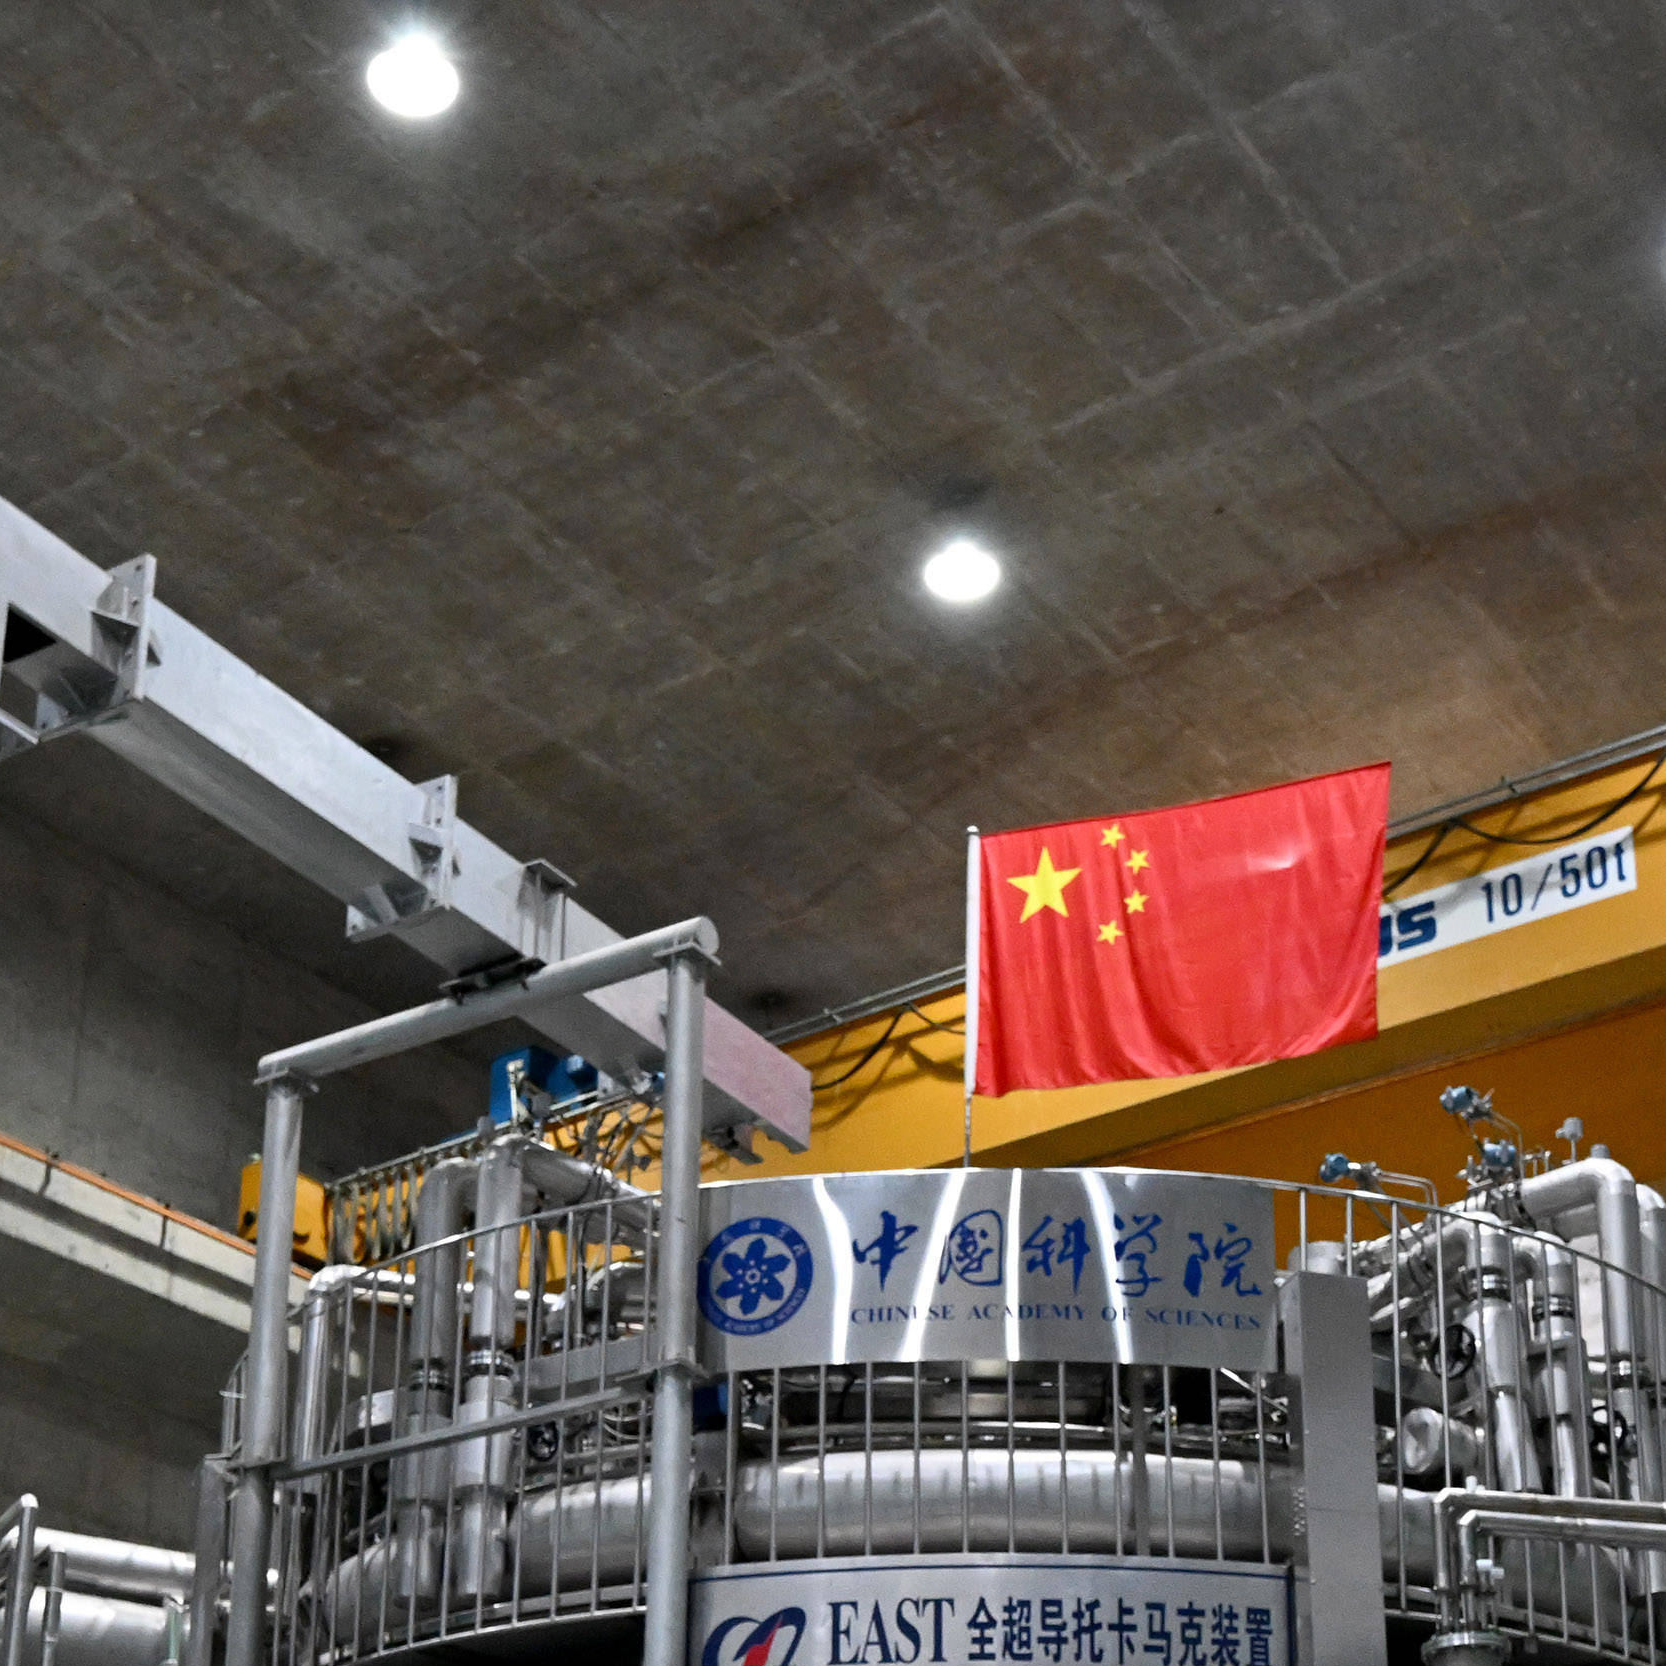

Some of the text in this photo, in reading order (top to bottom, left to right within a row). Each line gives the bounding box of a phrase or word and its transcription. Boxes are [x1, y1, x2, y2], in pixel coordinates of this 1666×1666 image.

[1481, 843, 1627, 923] 10/50t
[851, 1304, 955, 1324] CHINSE
[1146, 1308, 1260, 1330] SCIENCES
[827, 1597, 955, 1666] EAST
